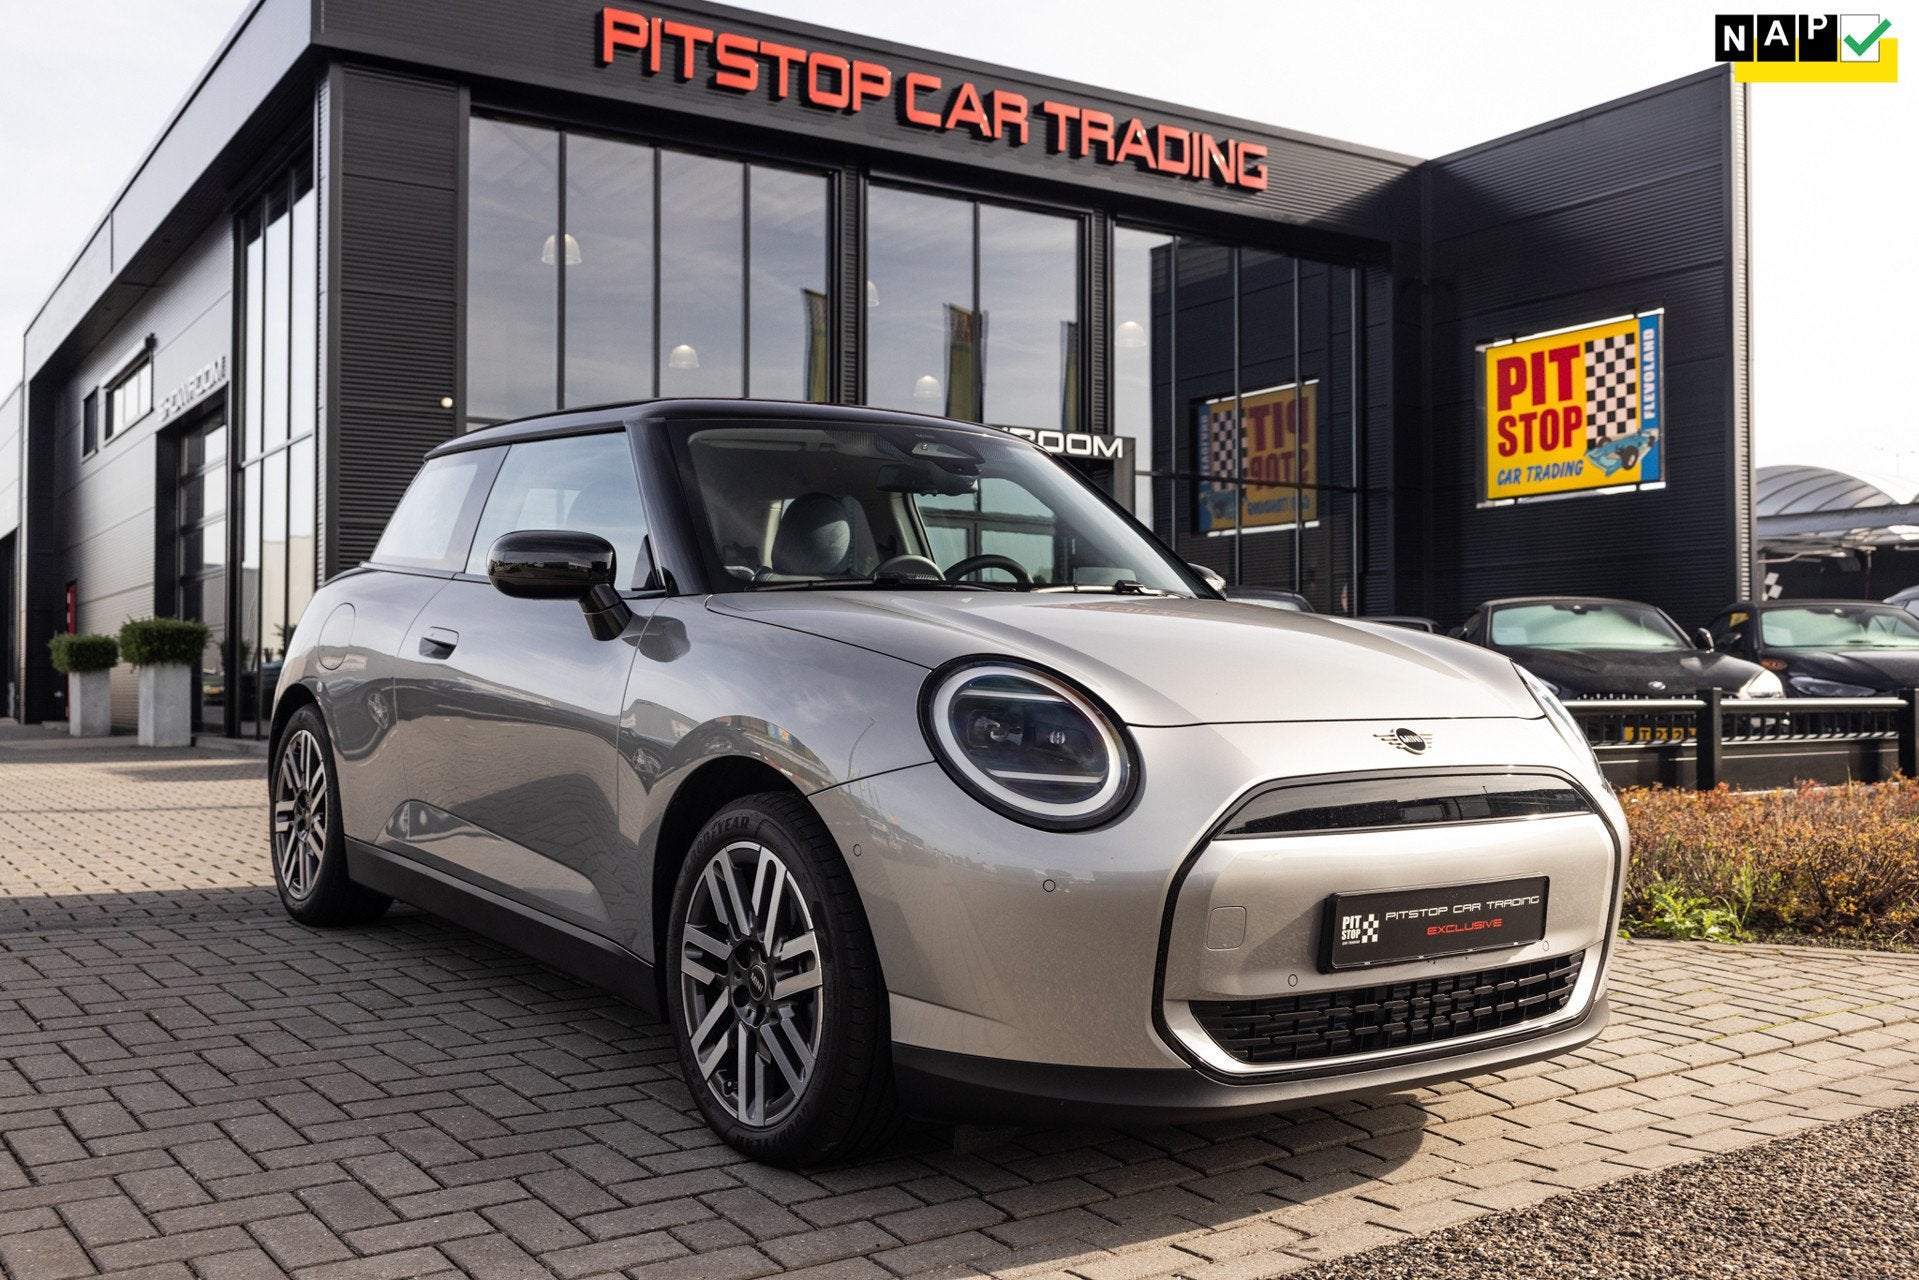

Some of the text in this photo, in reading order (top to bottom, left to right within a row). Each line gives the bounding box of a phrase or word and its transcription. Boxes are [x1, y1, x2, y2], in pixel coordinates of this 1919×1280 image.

[603, 7, 1268, 192] PITSTOP CAR TRADING
[1497, 343, 1581, 412] PIT
[1643, 328, 1656, 420] FLEVOLAND
[1002, 427, 1124, 459] ROOM
[1497, 405, 1583, 457] STOP
[1497, 460, 1584, 486] CAR TRADING
[1342, 914, 1362, 930] PIT
[1385, 895, 1540, 921] PITSTOP CAR TRADING
[1341, 929, 1361, 941] STOP
[1427, 918, 1503, 936] EXCLUSIVE
